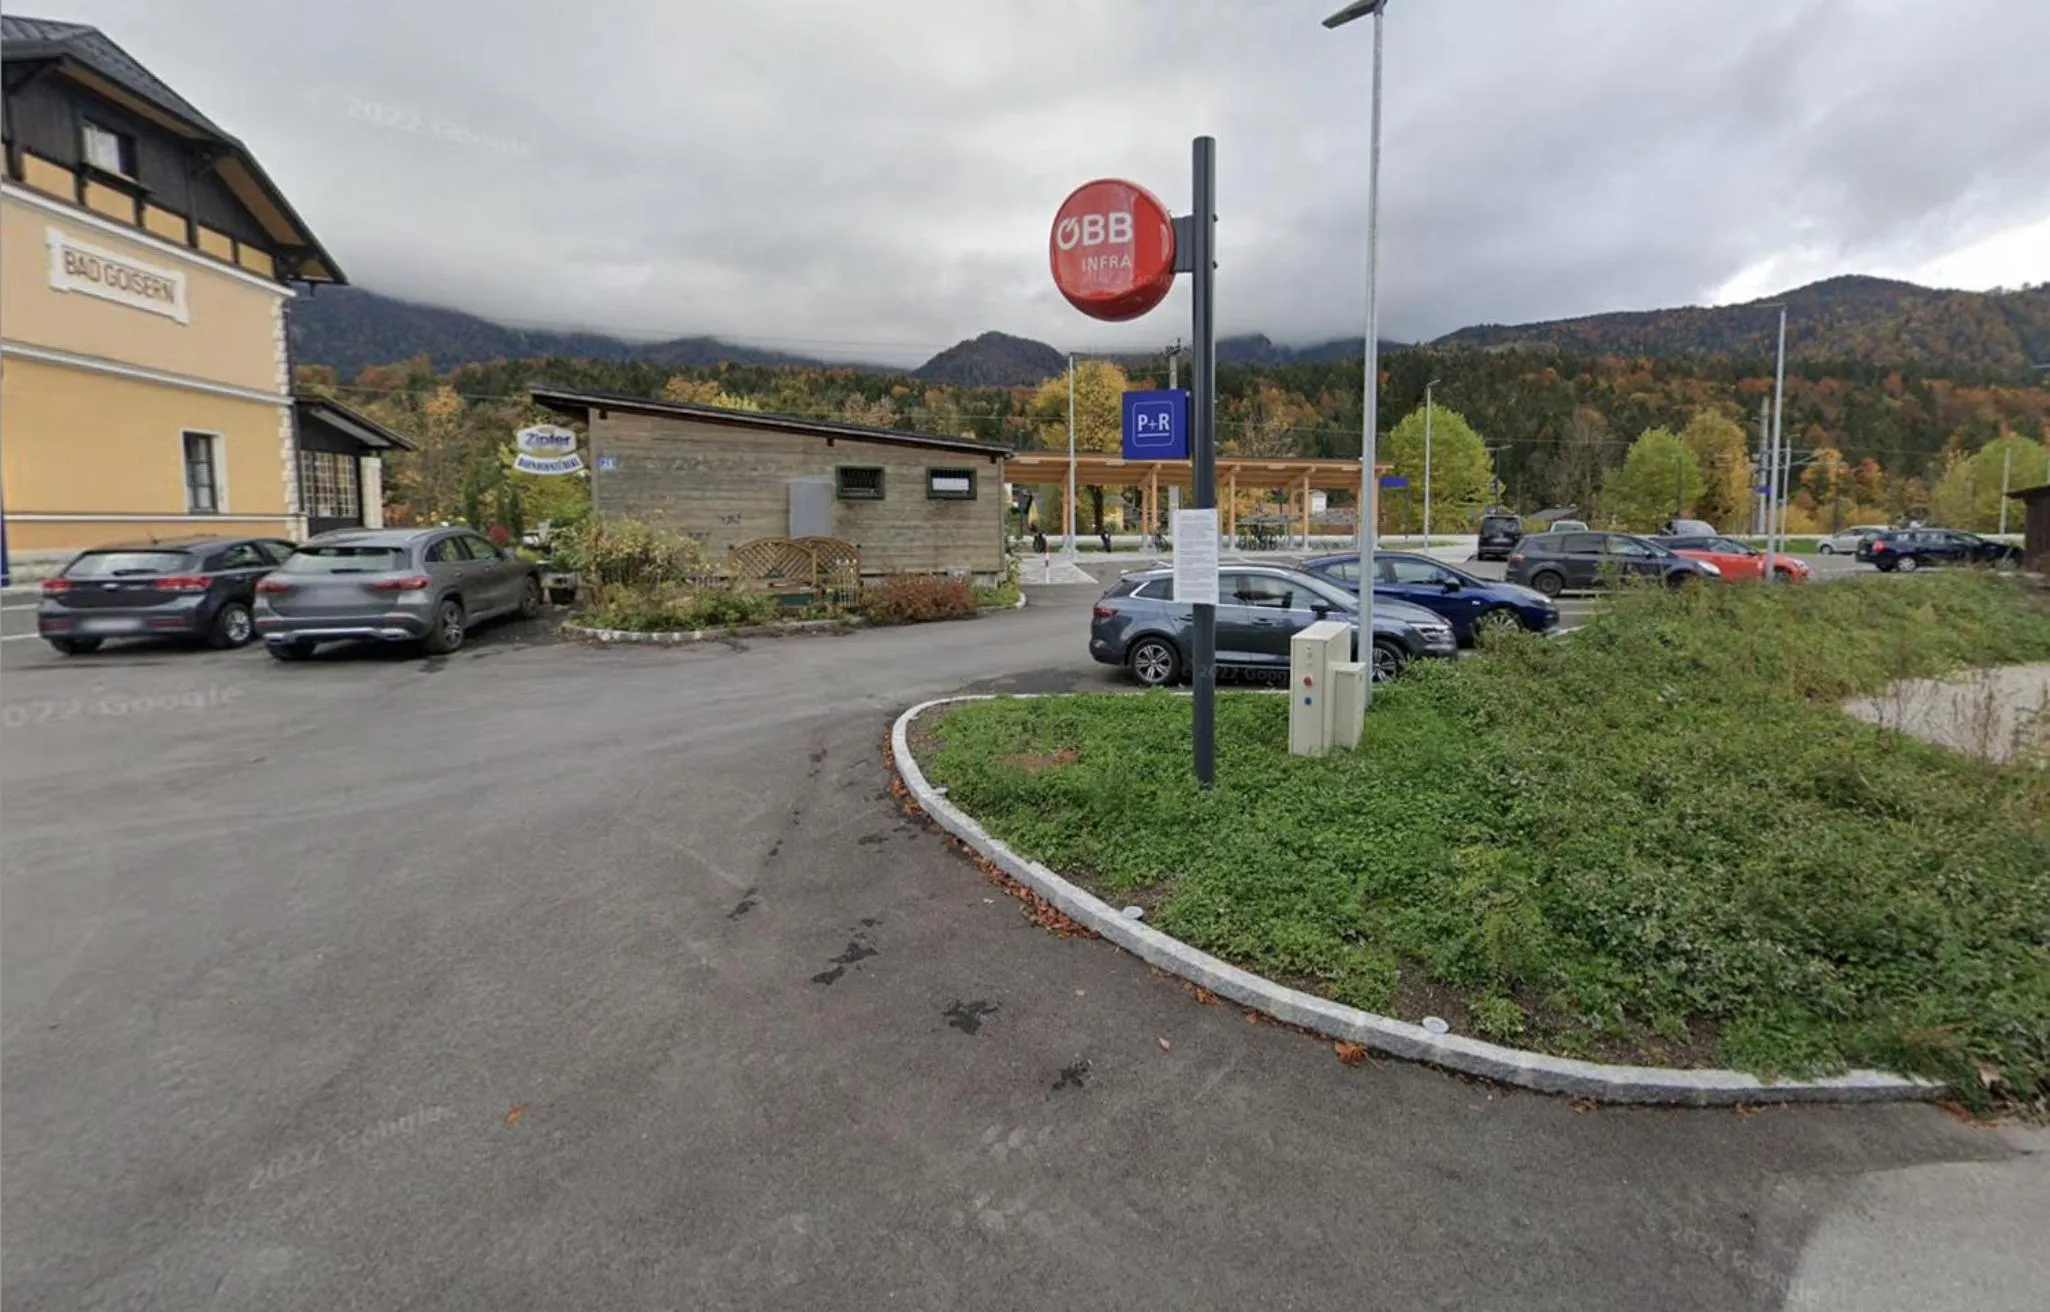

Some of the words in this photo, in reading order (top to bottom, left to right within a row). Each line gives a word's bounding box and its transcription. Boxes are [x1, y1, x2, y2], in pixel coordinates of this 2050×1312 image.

[1081, 255, 1132, 273] INFRA
[64, 250, 102, 283] BAD
[103, 263, 175, 304] GOISERN
[1137, 412, 1170, 432] P+R
